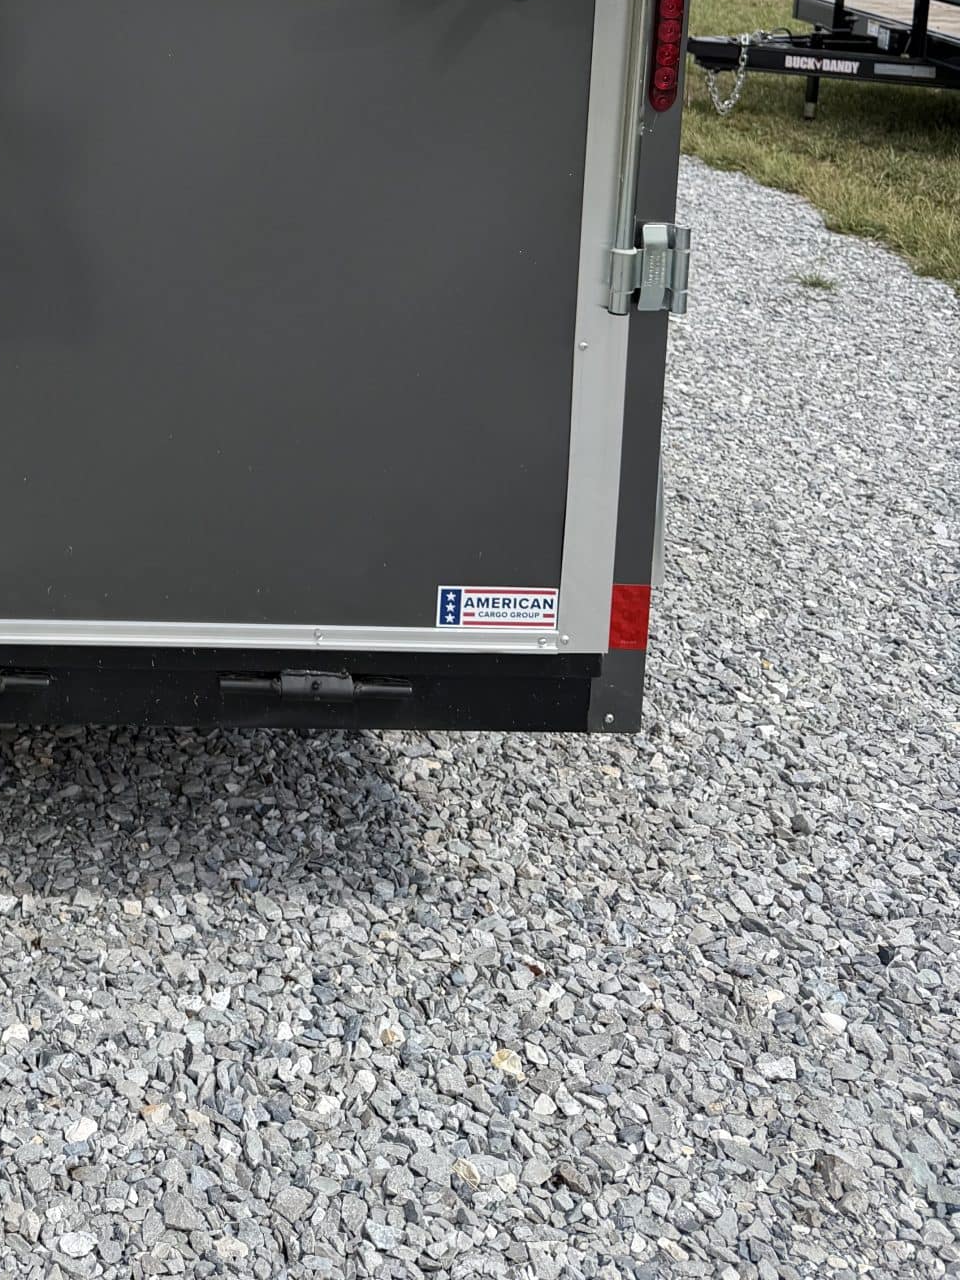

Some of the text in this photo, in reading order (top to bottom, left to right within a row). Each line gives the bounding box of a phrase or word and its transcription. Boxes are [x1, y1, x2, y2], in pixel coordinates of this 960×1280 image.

[784, 55, 860, 74] BUCK DANDY
[463, 597, 554, 610] AMERICAN
